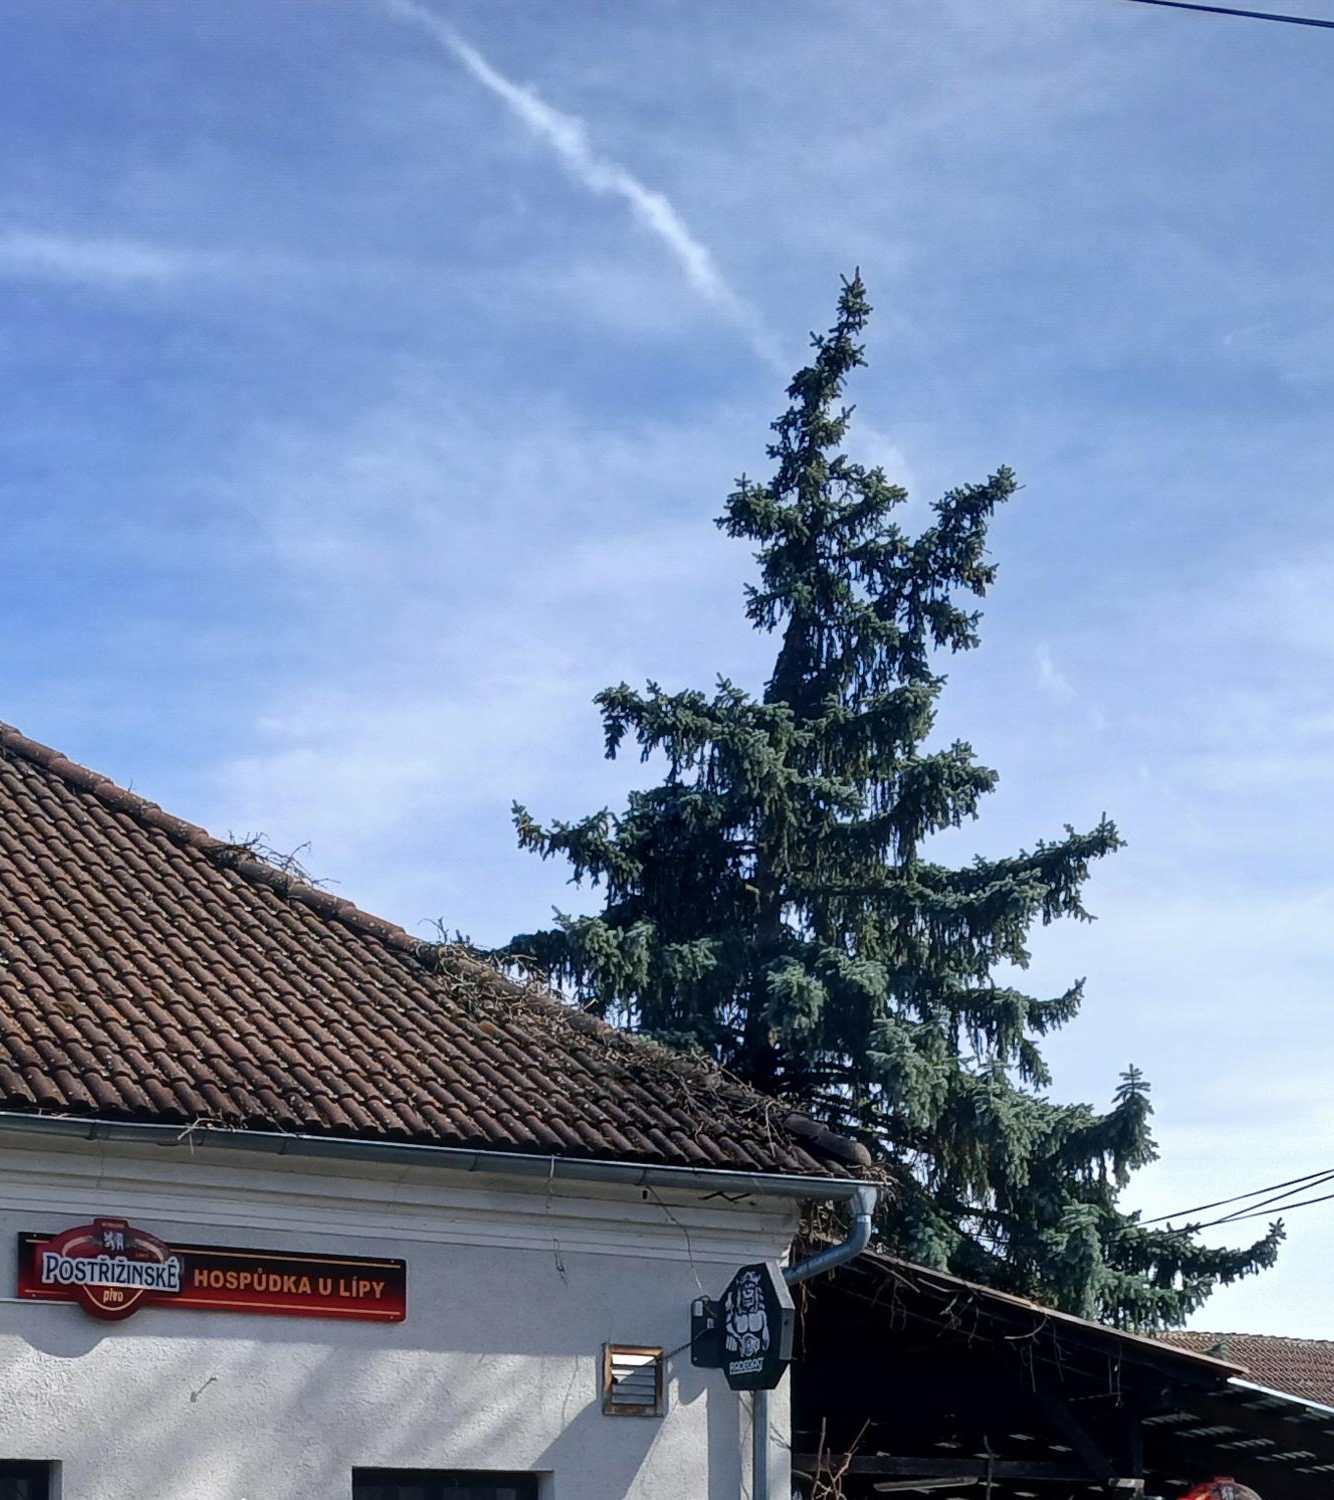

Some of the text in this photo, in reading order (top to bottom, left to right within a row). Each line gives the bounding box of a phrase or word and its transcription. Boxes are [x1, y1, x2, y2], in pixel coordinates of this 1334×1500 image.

[44, 1255, 178, 1288] POSTŘIŽINSKÉ
[193, 1267, 385, 1299] HOSPŮDKA U LÍPY
[102, 1288, 124, 1304] pivo
